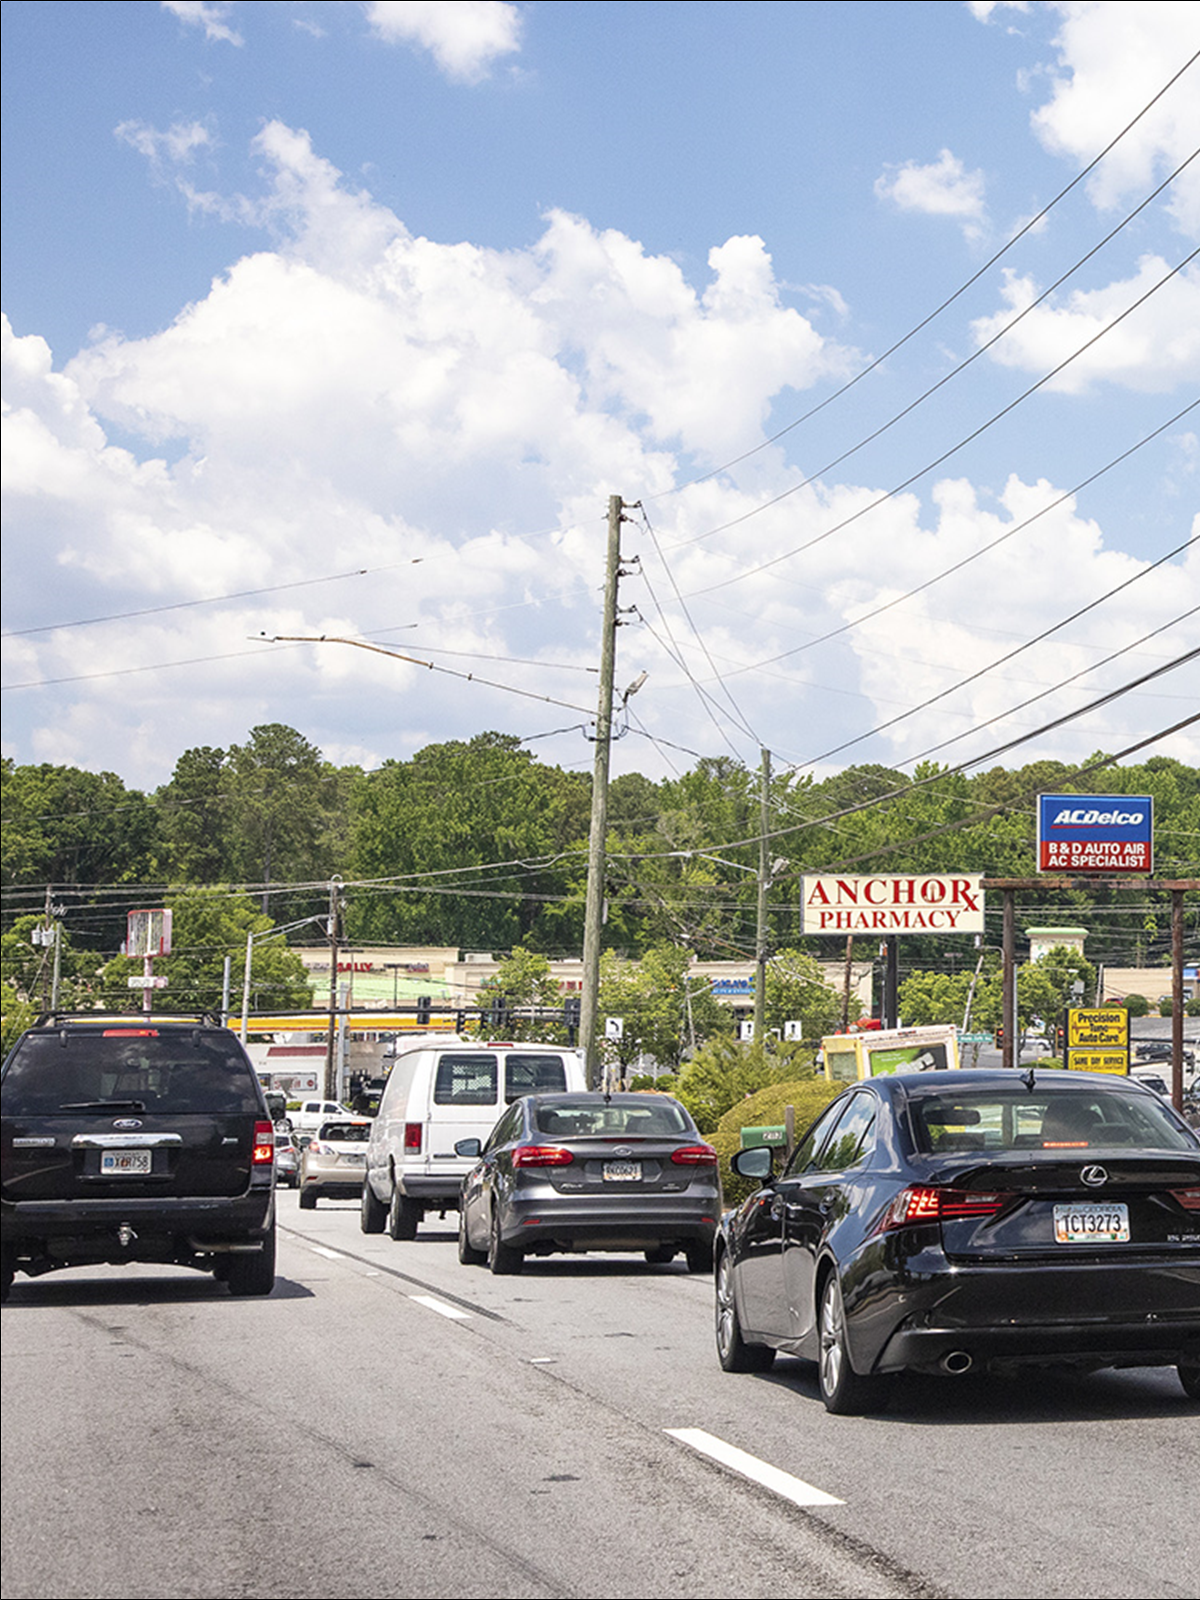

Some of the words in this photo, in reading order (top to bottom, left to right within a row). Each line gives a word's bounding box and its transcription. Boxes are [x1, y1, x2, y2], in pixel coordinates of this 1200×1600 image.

[1052, 809, 1144, 825] ACDelco
[1048, 842, 1058, 854] B
[1059, 842, 1070, 854] &
[1072, 842, 1082, 854] D
[1083, 843, 1121, 855] AUTO
[1123, 843, 1145, 855] AIR
[1048, 855, 1068, 867] AC
[1070, 855, 1145, 867] SPECIALIST
[819, 910, 961, 929] PHARMACY
[1078, 1012, 1121, 1023] Precision
[1090, 1023, 1109, 1032] Tune
[1078, 1033, 1098, 1043] Auto
[1099, 1033, 1120, 1043] Care
[1062, 1214, 1122, 1233] TCT3273
